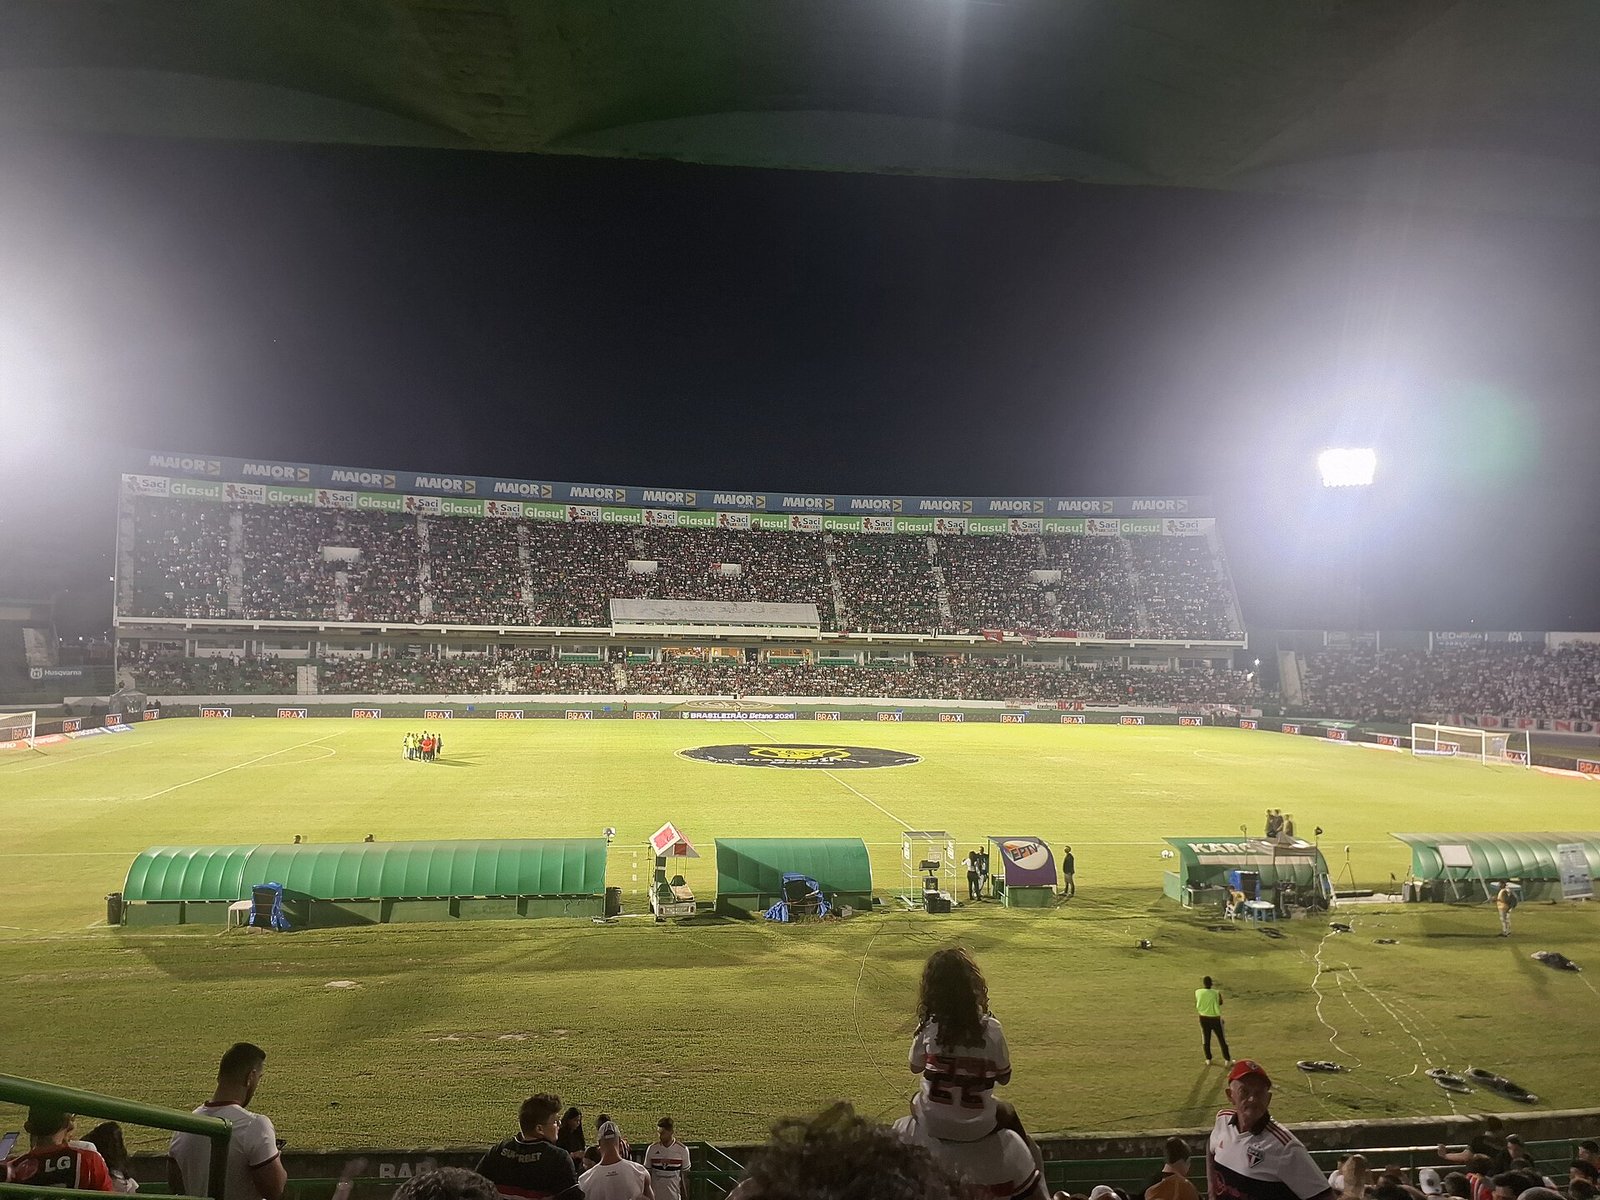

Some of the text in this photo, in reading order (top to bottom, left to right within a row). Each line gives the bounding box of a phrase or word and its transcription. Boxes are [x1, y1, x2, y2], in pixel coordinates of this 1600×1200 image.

[150, 455, 206, 472] MAIOR
[242, 463, 295, 479] MAIOR
[331, 470, 382, 484] MAIOR
[142, 478, 167, 489] Saci
[415, 476, 462, 490] MAIOR
[239, 486, 263, 496] Saci
[494, 482, 539, 495] MAIOR
[570, 486, 613, 499] MAIOR
[332, 492, 354, 503] Saci
[643, 490, 684, 502] MAIOR
[713, 494, 754, 506] MAIOR
[418, 498, 439, 508] Saci
[782, 497, 823, 508] MAIOR
[851, 499, 890, 510] MAIOR
[920, 500, 960, 511] MAIOR
[990, 500, 1031, 511] MAIOR
[1058, 500, 1100, 511] MAIOR
[1131, 500, 1175, 511] MAIOR
[500, 504, 520, 513] Saci
[580, 508, 599, 517] Saci
[656, 512, 675, 520] Saci
[730, 515, 748, 524] Saci
[802, 516, 820, 525] Saci
[875, 518, 893, 527] Saci
[947, 520, 966, 529] Saci
[1022, 520, 1040, 529] Saci
[1099, 520, 1119, 529] Saci
[1179, 520, 1199, 529] Saci
[44, 669, 82, 677] Husqvarna
[144, 710, 158, 720] BRAX
[203, 710, 229, 718] BRAX
[280, 710, 304, 718] BRAX
[354, 710, 378, 718] BRAX
[427, 711, 450, 720] BRAX
[498, 711, 521, 720] BRAX
[567, 712, 590, 720] BRAX
[635, 711, 657, 720] BRAX
[880, 713, 900, 721] BRAX
[941, 714, 962, 722] BRAX
[1002, 715, 1022, 723] BRAX
[107, 715, 121, 726] BRAX
[1063, 716, 1083, 724] BRAX
[1122, 717, 1142, 725] BRAX
[1181, 718, 1201, 726] BRAX
[1454, 715, 1600, 733] INDEPEND
[64, 721, 80, 732] BRAX
[1241, 721, 1256, 730] BRAX
[1283, 725, 1299, 734] BRAX
[14, 728, 32, 740] BRAX
[1328, 730, 1346, 740] BRAX
[1378, 735, 1398, 746] BRAX
[1010, 843, 1038, 861] EPTV
[45, 1155, 71, 1172] LG
